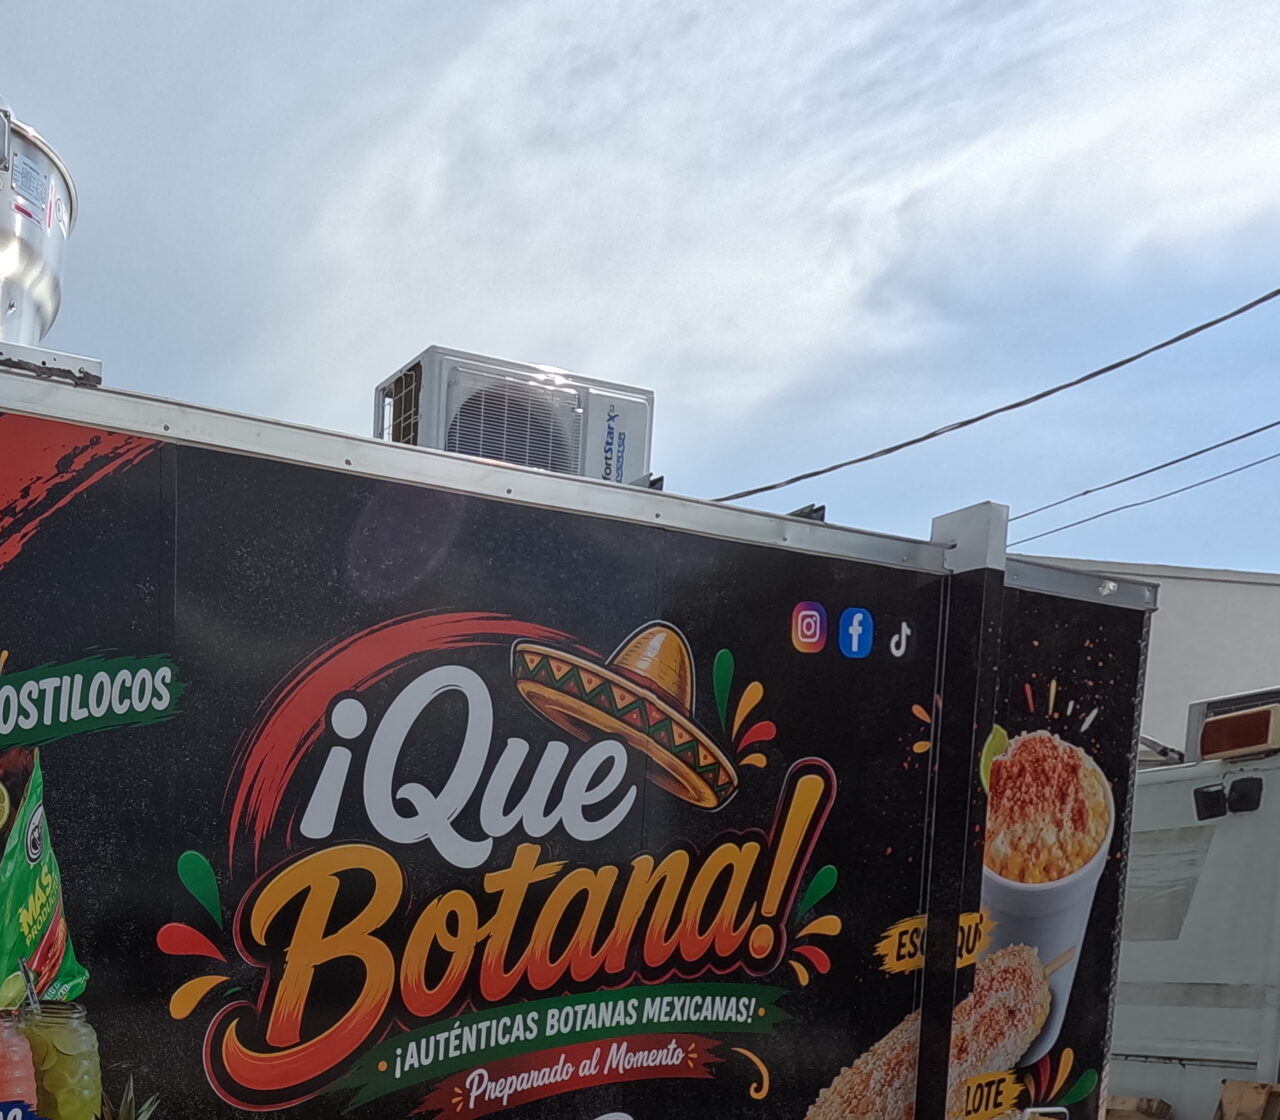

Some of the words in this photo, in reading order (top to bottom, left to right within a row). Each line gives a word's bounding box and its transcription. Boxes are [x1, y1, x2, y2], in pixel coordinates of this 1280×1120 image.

[222, 774, 827, 1092] Botana!
[394, 1012, 538, 1079] ¡AUTÉNTICAS
[545, 998, 638, 1038] BOTANAS
[642, 995, 757, 1024] MEXICANAS!
[466, 1054, 576, 1109] Preparado
[578, 1052, 600, 1077] al
[604, 1038, 685, 1076] Momento
